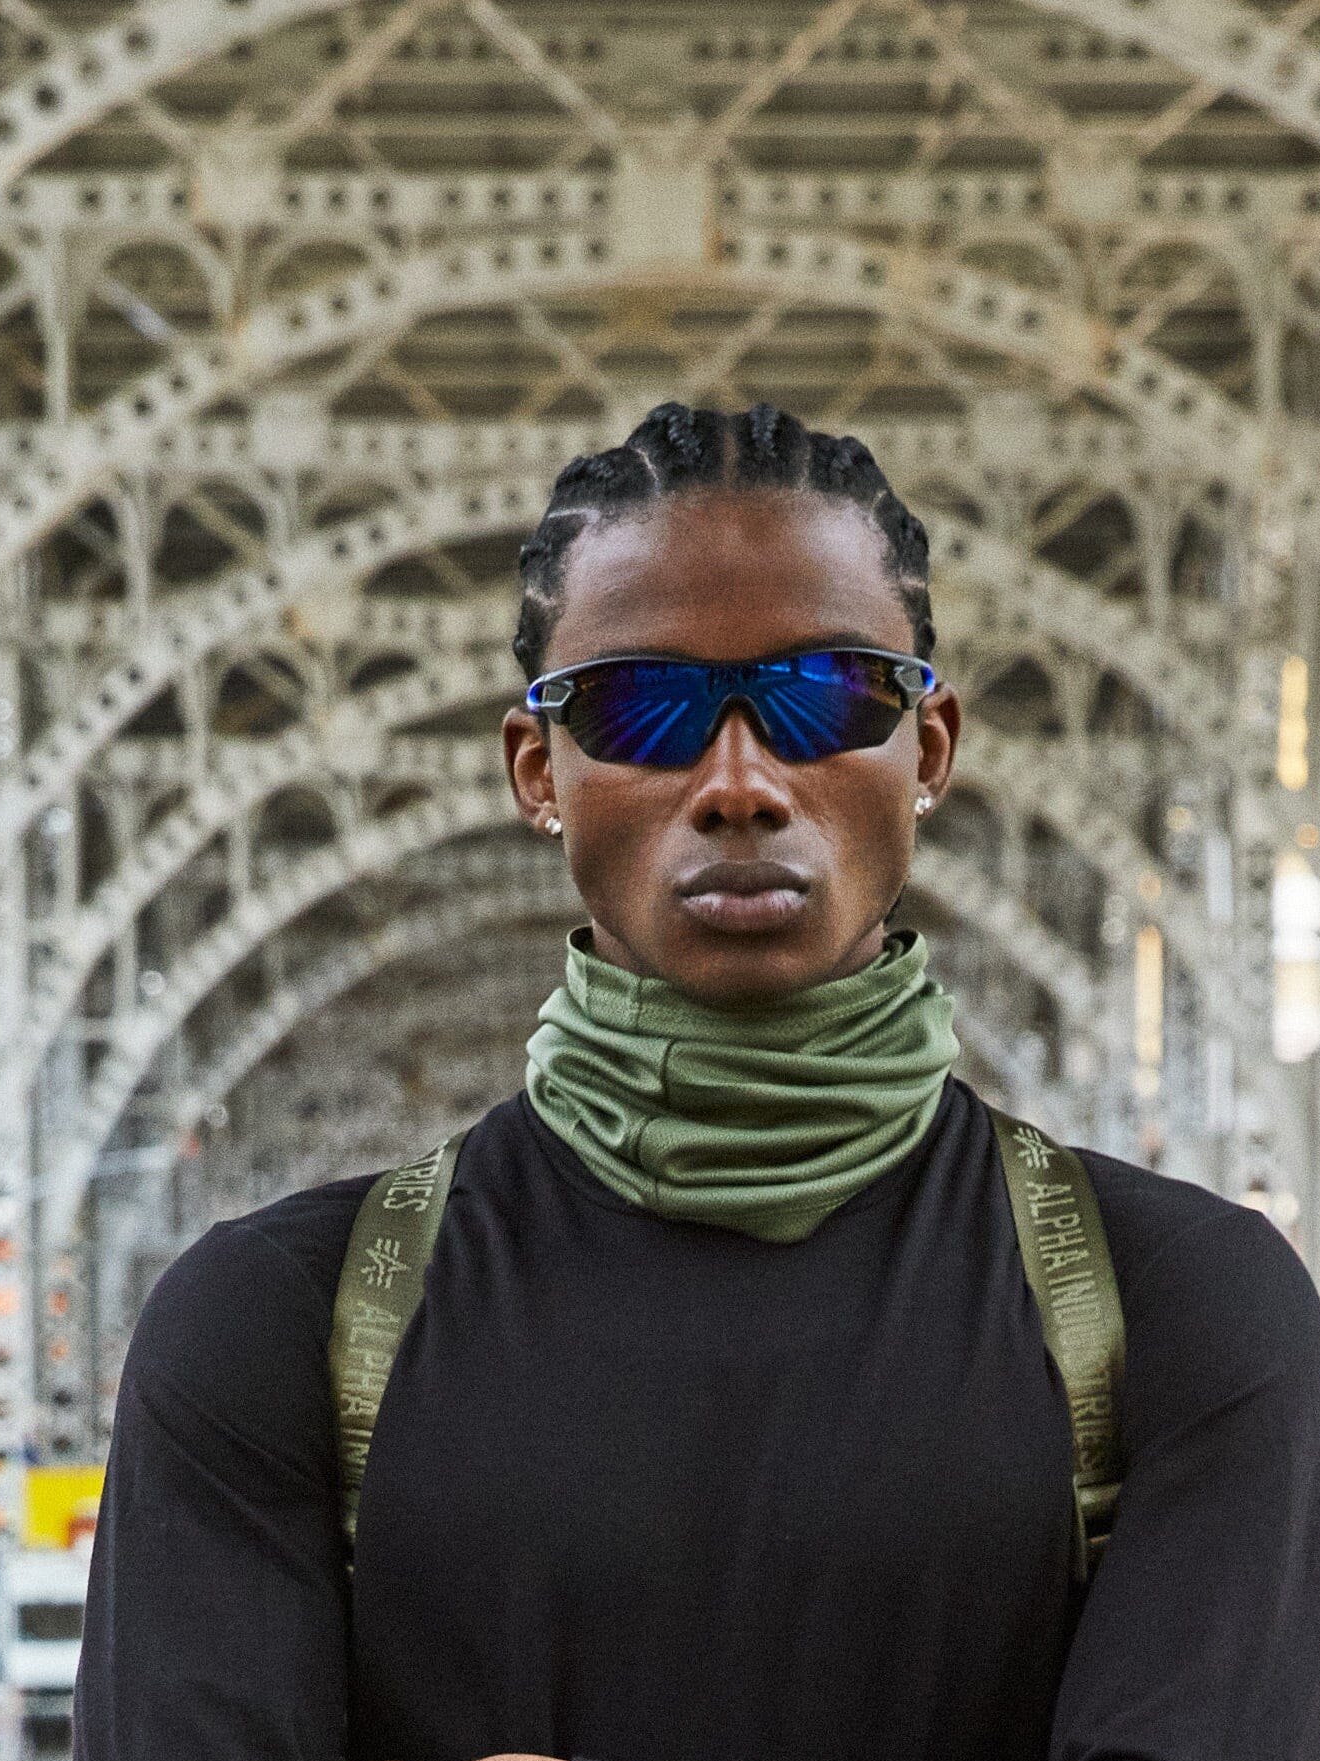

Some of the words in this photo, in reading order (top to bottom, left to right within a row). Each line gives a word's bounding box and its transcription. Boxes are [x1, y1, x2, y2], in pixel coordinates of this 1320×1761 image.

[383, 1141, 448, 1212] TRIES
[1026, 1181, 1090, 1273] ALPHA
[339, 1301, 401, 1416] ALPHA
